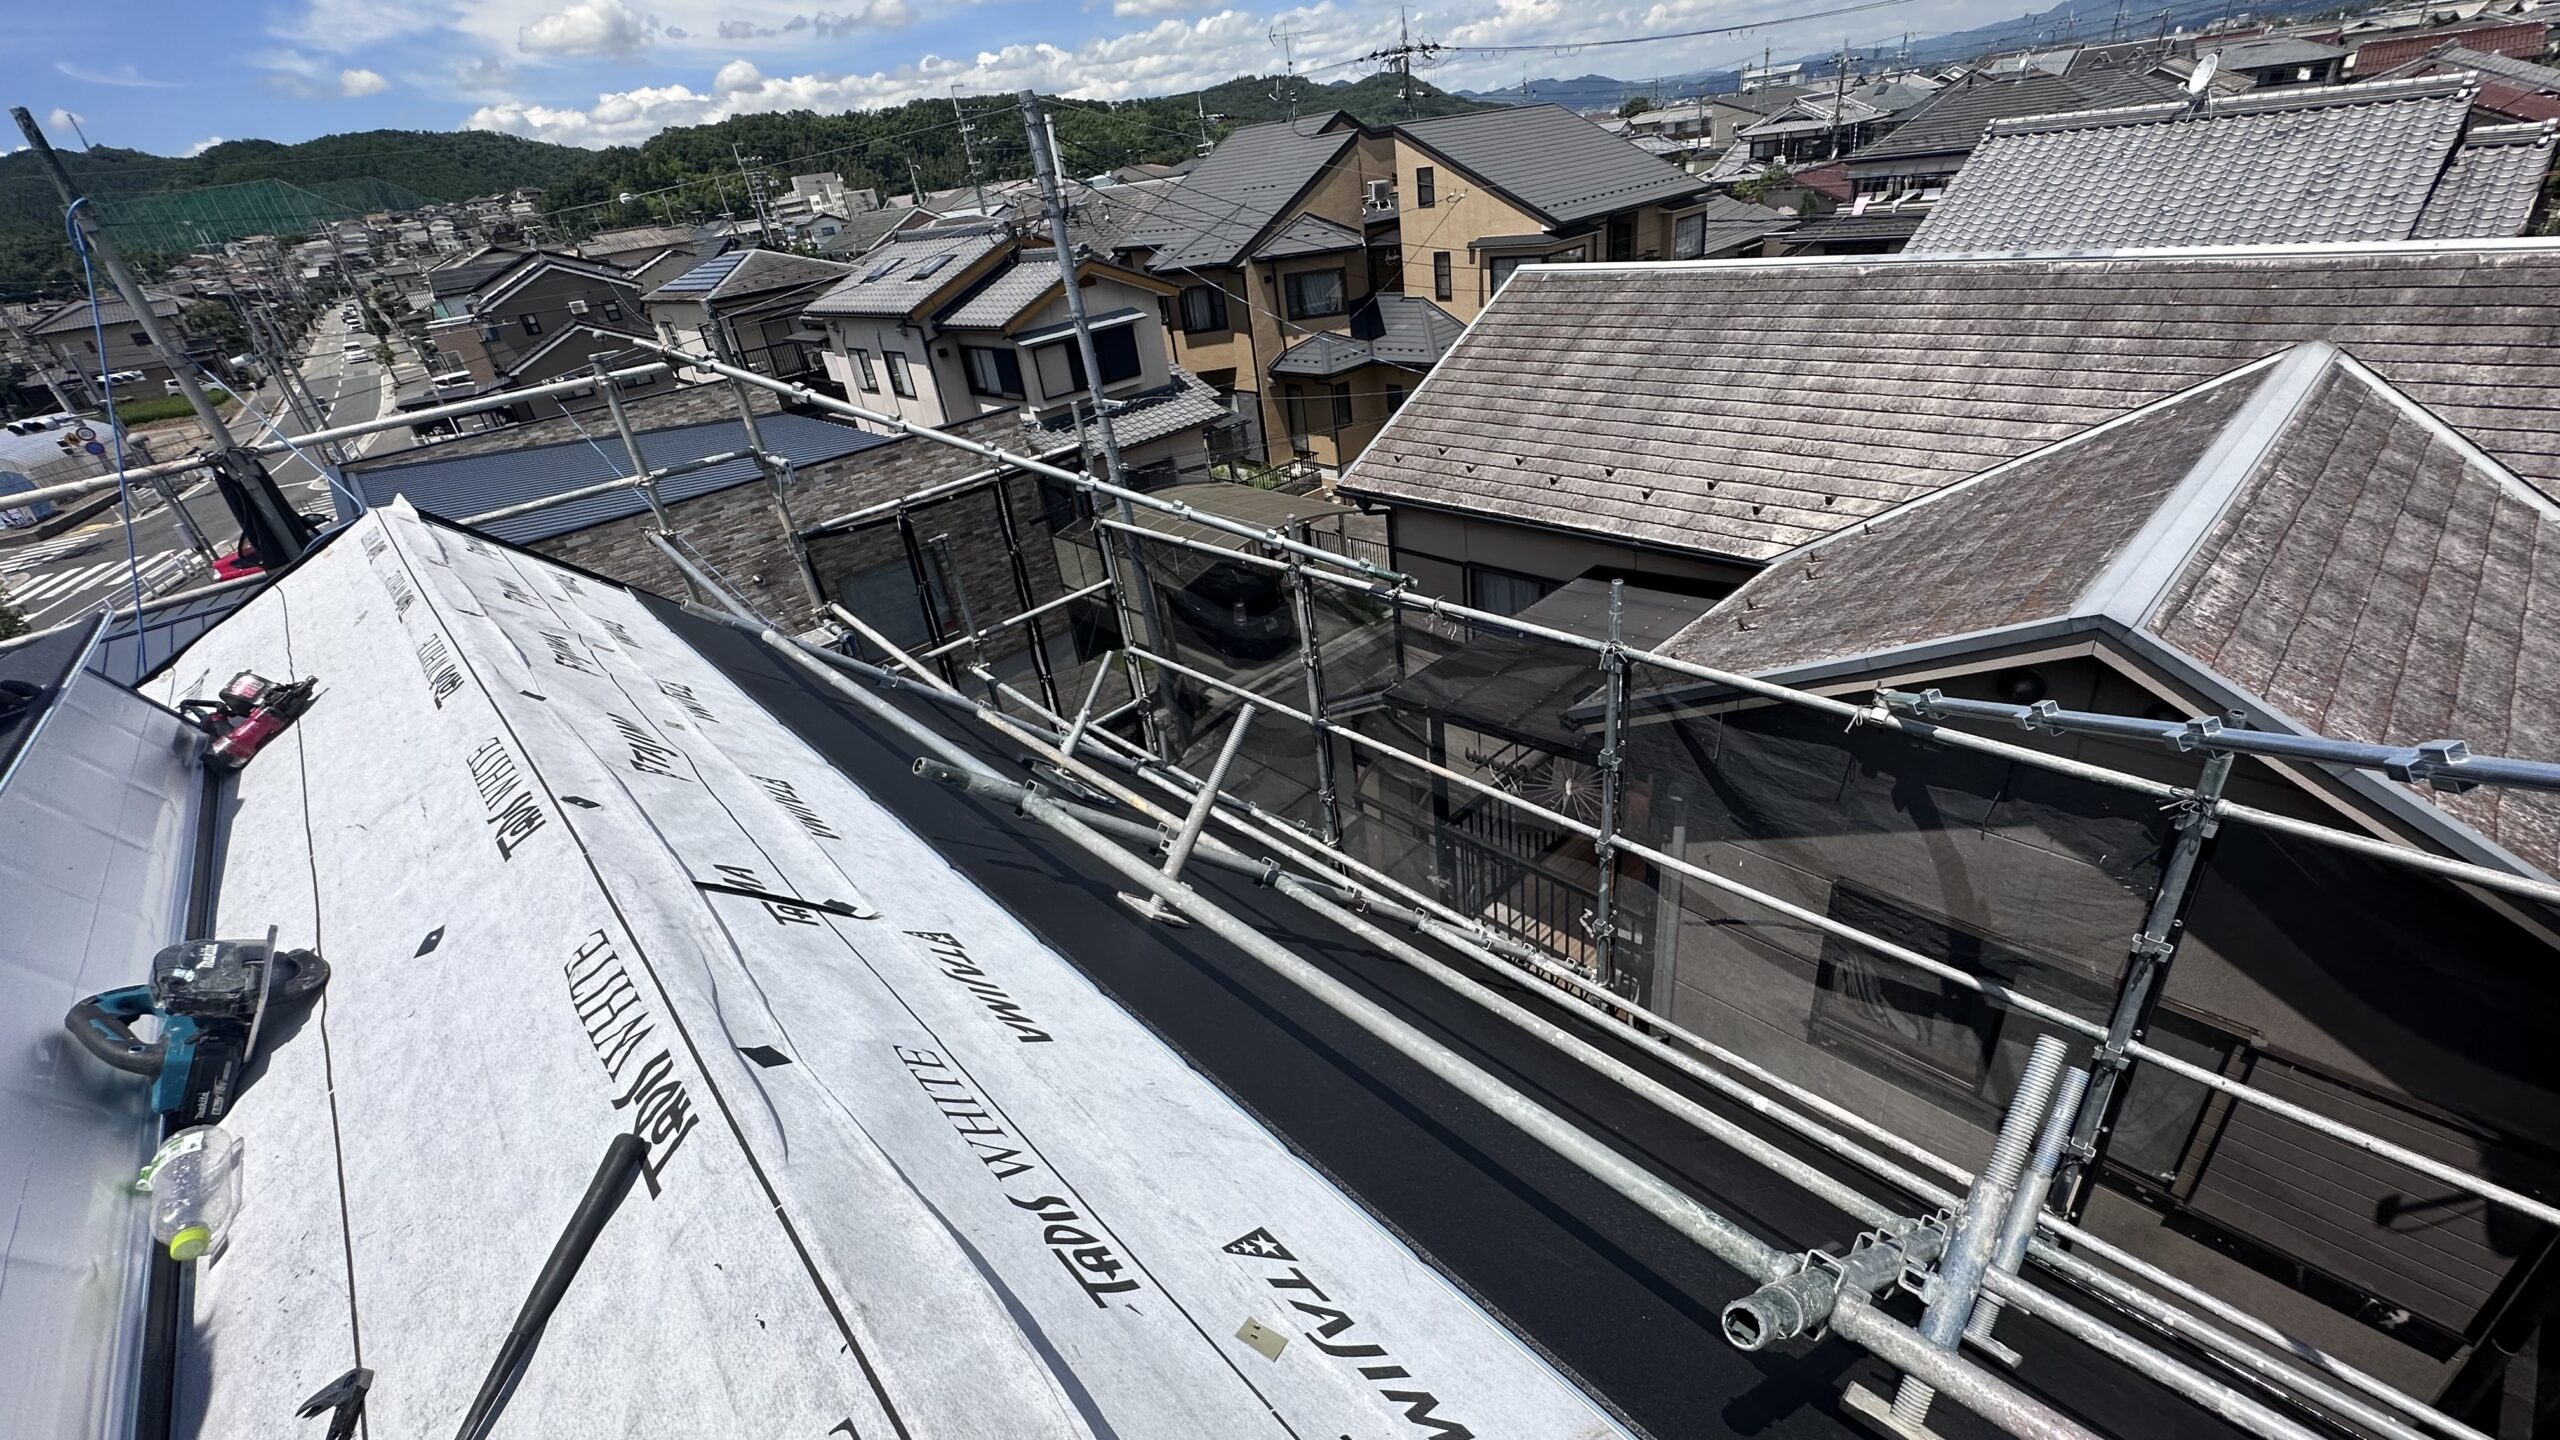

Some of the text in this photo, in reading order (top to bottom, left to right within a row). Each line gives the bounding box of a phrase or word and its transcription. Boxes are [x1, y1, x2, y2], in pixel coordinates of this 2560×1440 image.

[466, 736, 523, 811] WHITE
[763, 784, 841, 840] TAJIMA
[563, 928, 656, 1083] WHITE
[928, 947, 1054, 1043] TAJIMA
[892, 1043, 1141, 1309] WHITE TADIS
